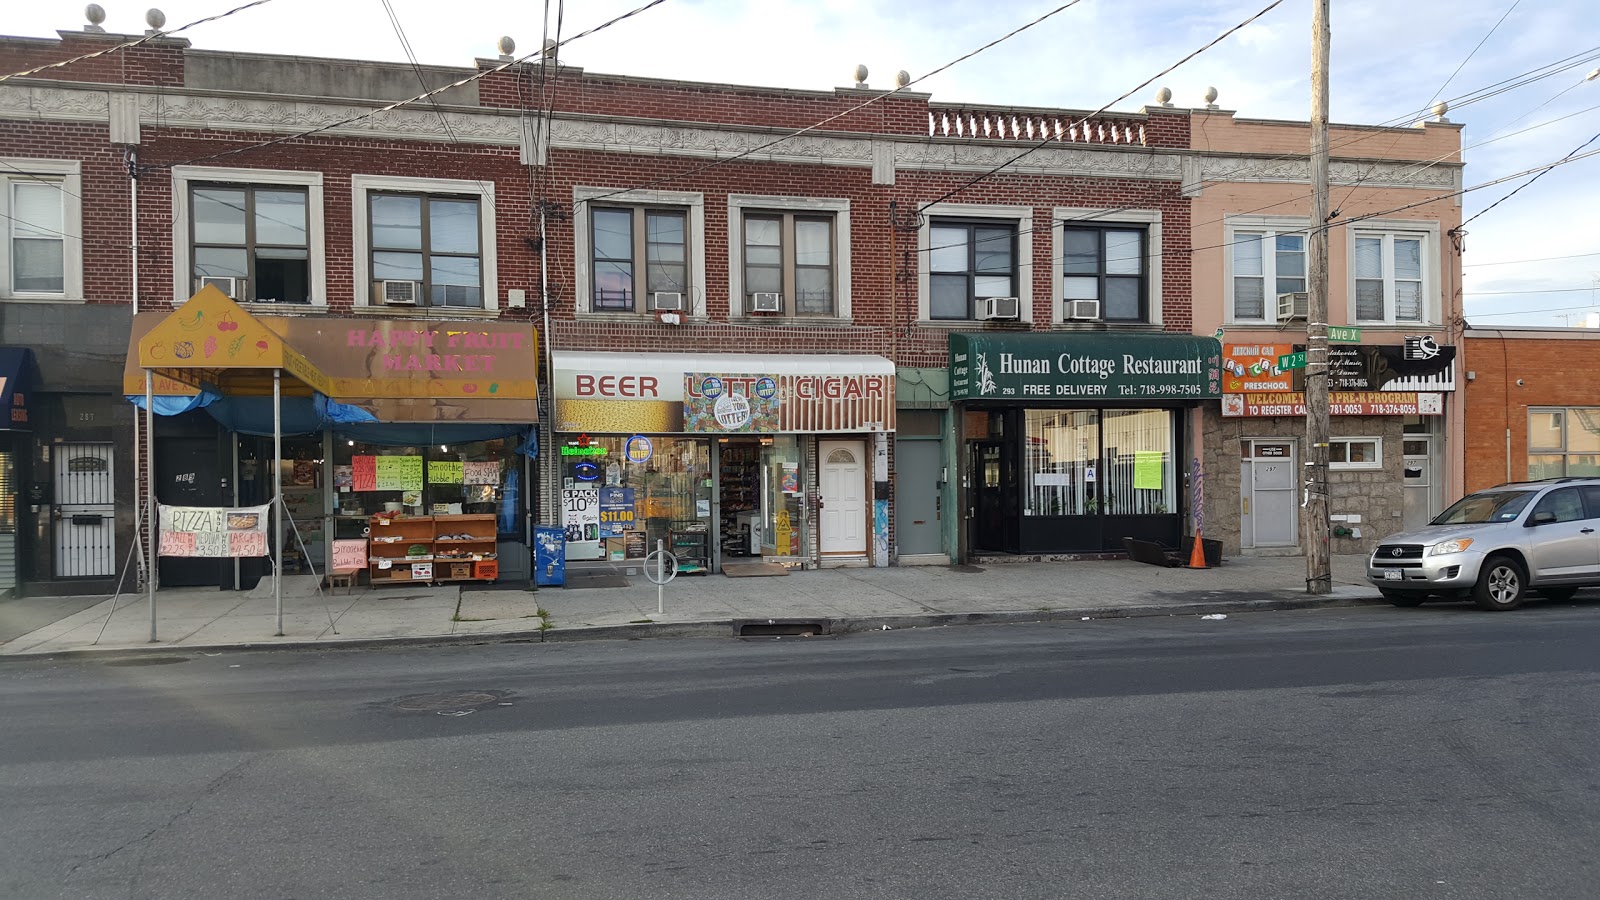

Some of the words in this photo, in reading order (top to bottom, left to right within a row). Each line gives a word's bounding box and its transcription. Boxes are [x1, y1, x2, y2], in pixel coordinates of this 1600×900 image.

[347, 329, 438, 348] HAPPY
[446, 331, 527, 349] FRUIT
[1331, 329, 1348, 340] Ave
[1351, 329, 1357, 340] X
[383, 353, 497, 372] MARKET
[999, 353, 1050, 374] Hunan
[1058, 353, 1116, 380] Cottage
[1122, 354, 1203, 375] Restaurant
[1282, 357, 1289, 368] W
[1291, 355, 1296, 367] 2
[159, 378, 178, 391] AVE
[576, 374, 659, 398] BEER
[796, 378, 883, 399] CIGAR
[1002, 387, 1016, 395] 293
[1023, 384, 1051, 395] FREE
[1056, 384, 1108, 395] DELIVERY
[1118, 384, 1137, 395] Tel:
[1140, 384, 1202, 395] 718-998-7505
[1244, 382, 1289, 390] PRESCHOOL
[1247, 393, 1299, 405] WELCOME
[1336, 392, 1366, 404] PRE-K
[1367, 392, 1417, 404] PROGRAM
[1249, 405, 1259, 415] TO
[1261, 405, 1292, 415] REGISTER
[1294, 405, 1308, 415] CAL
[1329, 404, 1363, 414] -781-0053
[1370, 404, 1417, 414] 718-376-8056
[79, 413, 94, 421] 287
[718, 410, 749, 425] LOTTERY
[561, 446, 608, 456] Heineken
[465, 468, 482, 480] Food
[1087, 469, 1094, 478] A
[353, 474, 376, 490] PIZZA
[564, 490, 570, 498] 6
[572, 490, 597, 498] PACK
[172, 510, 212, 532] PIZZA
[600, 510, 634, 522] $11.00
[164, 532, 186, 544] SMALL
[230, 532, 254, 544] LARGE
